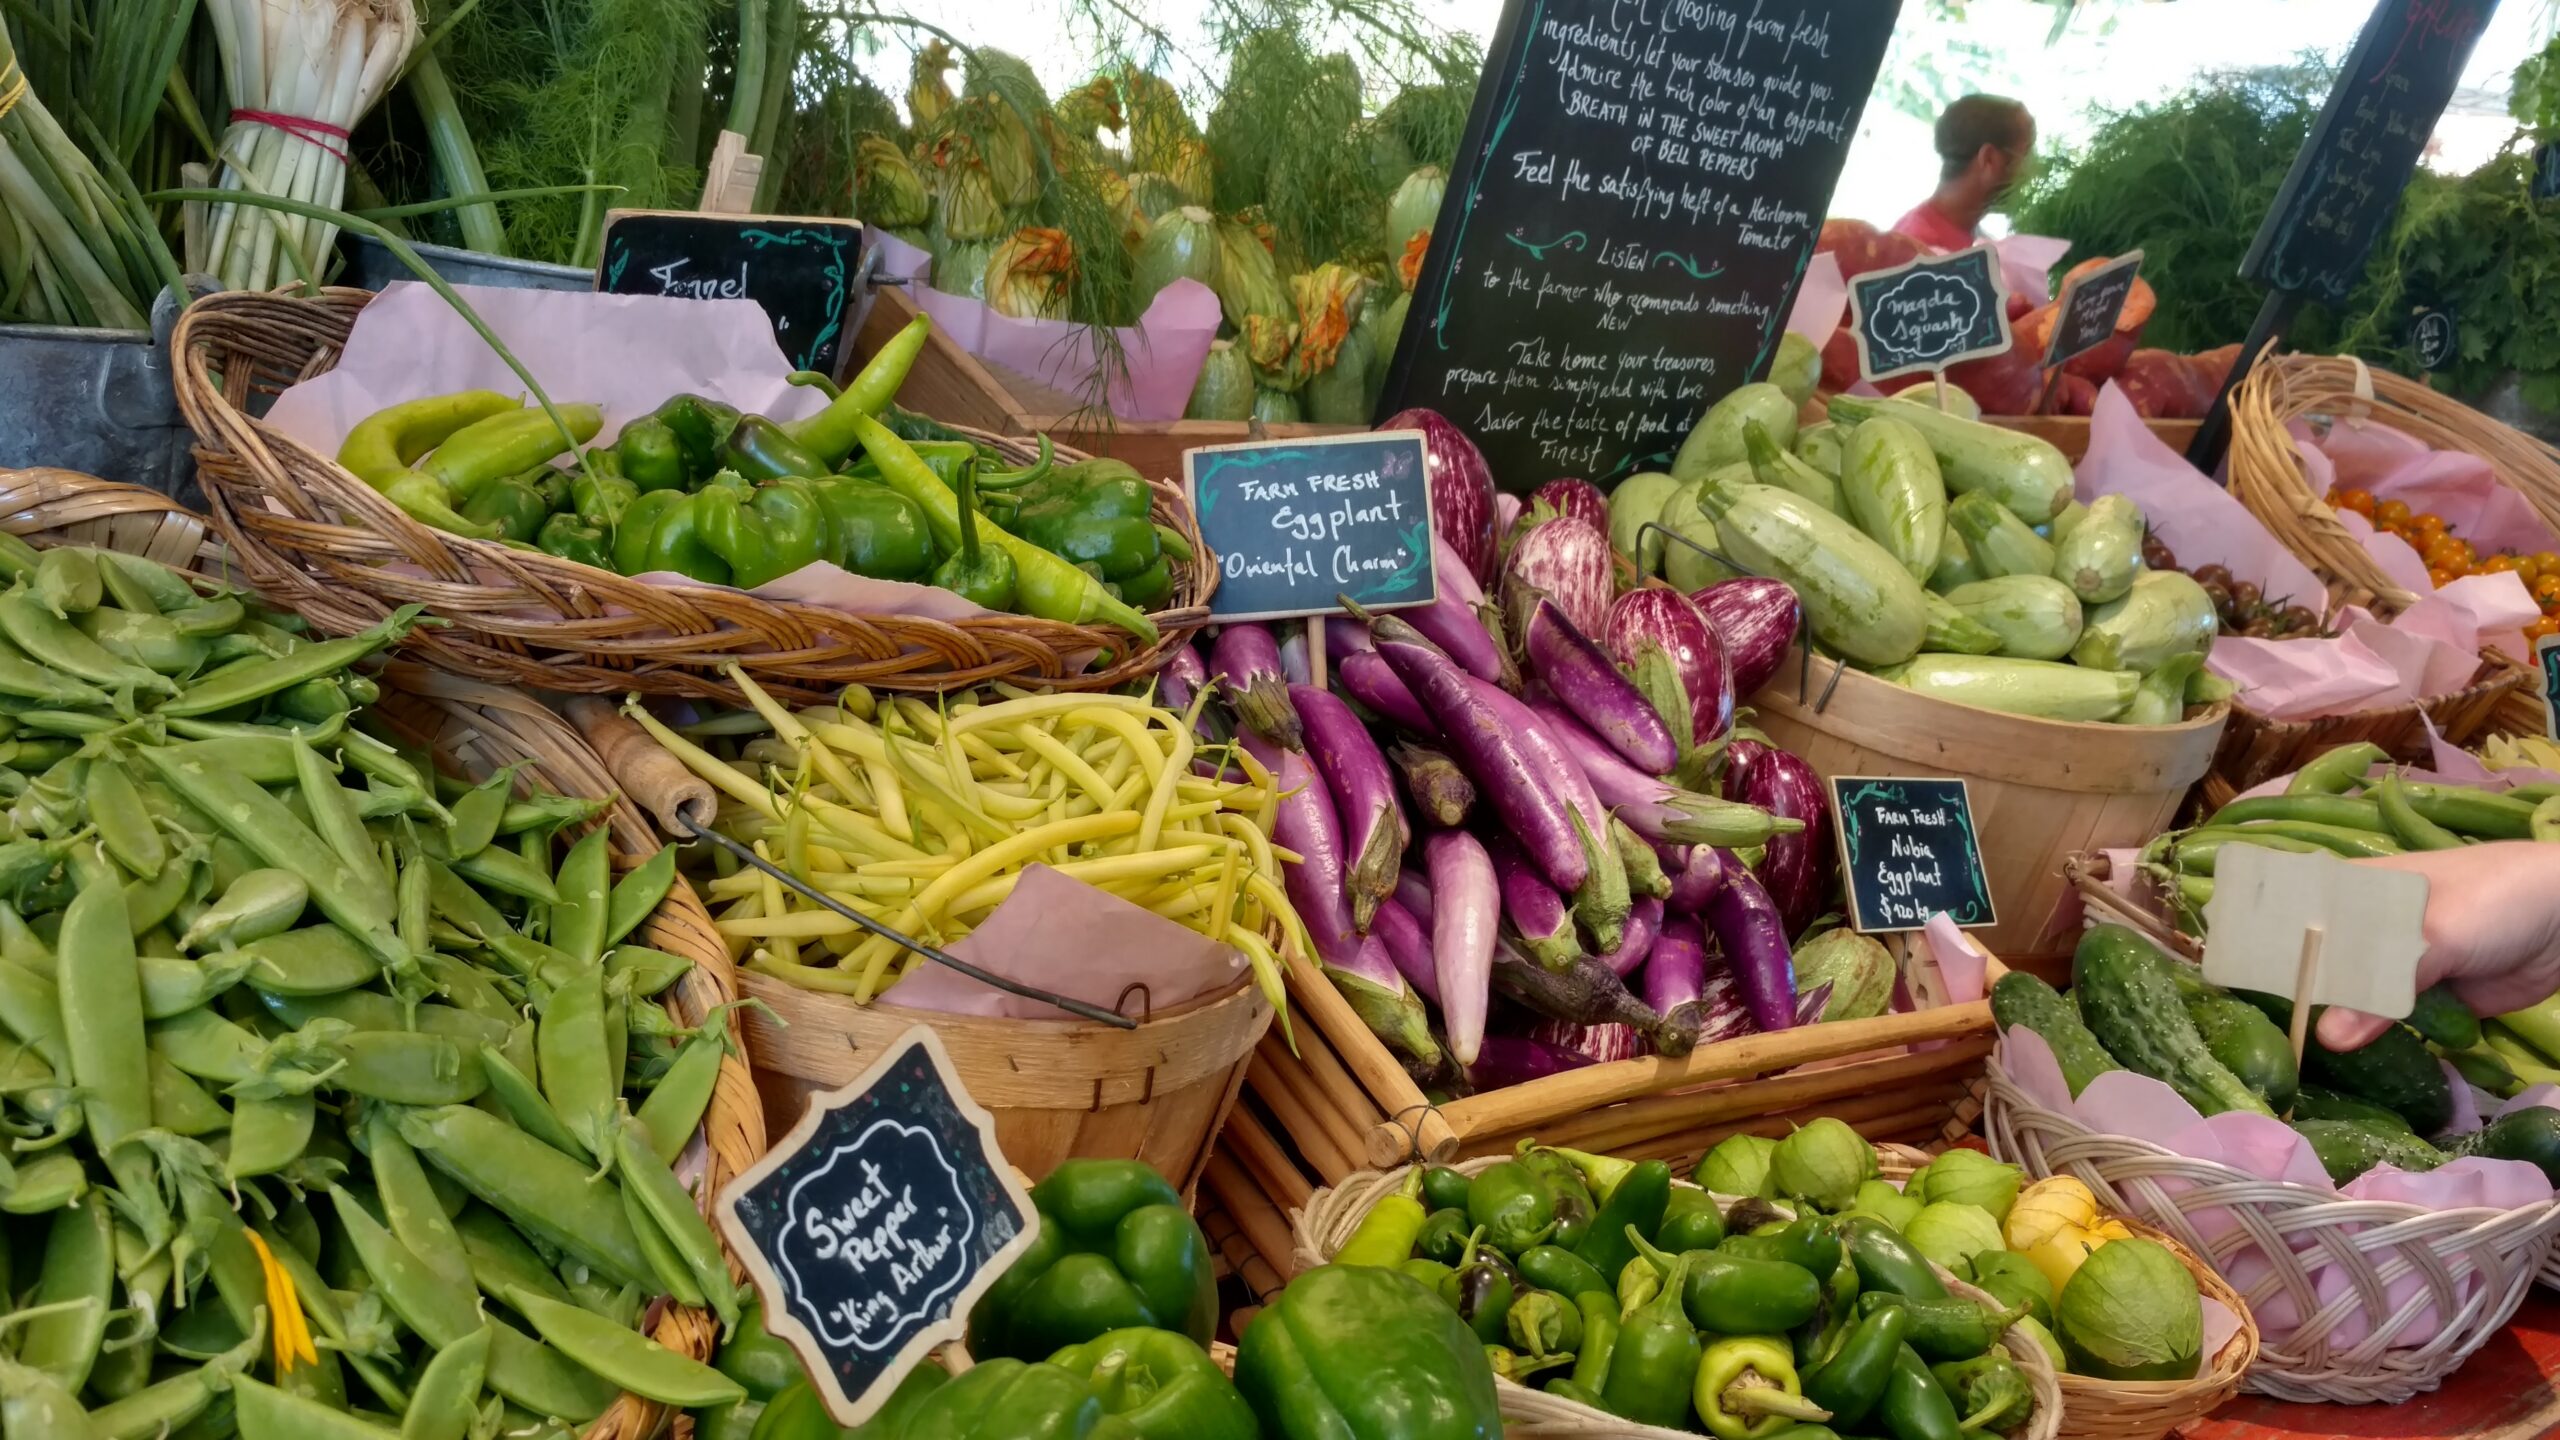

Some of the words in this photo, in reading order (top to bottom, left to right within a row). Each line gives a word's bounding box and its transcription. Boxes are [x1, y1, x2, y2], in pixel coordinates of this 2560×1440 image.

[1557, 50, 1623, 103] Admire
[1629, 71, 1656, 101] the
[1736, 94, 1757, 132] of
[1757, 106, 1776, 130] an
[1643, 34, 1667, 69] let
[1665, 52, 1702, 91] your
[1704, 60, 1755, 88] senses
[1753, 64, 1802, 111] guide
[1565, 90, 1628, 126] BREATH
[1661, 113, 1688, 138] THE
[1691, 121, 1741, 148] SWEET
[1740, 131, 1784, 160] AROMA
[1631, 135, 1654, 153] OF
[1657, 138, 1689, 165] BELL
[1699, 148, 1759, 181] PEPPERS
[1512, 150, 1556, 185] Feel
[1561, 158, 1591, 202] the
[1598, 165, 1675, 220] satisfying
[1680, 181, 1712, 226] heft
[1713, 193, 1731, 226] of
[1728, 203, 1741, 216] a
[1737, 223, 1796, 250] Tomato
[1483, 260, 1501, 288] to
[1507, 266, 1531, 297] the
[1535, 271, 1588, 310] farmer
[1626, 291, 1699, 316] recommends
[1706, 289, 1769, 331] something
[1596, 307, 1633, 331] NEW
[1508, 335, 1551, 367] Take
[1560, 342, 1608, 371] home
[1612, 351, 1648, 390] your
[1442, 367, 1498, 396] prepare
[1503, 367, 1540, 396] them
[1548, 374, 1600, 408] simply
[1599, 377, 1633, 399] and
[1640, 376, 1668, 408] with
[1474, 402, 1525, 432] Savor
[1531, 408, 1563, 439] the
[1564, 406, 1609, 439] taste
[1615, 410, 1635, 441] of
[1634, 413, 1670, 443] food
[1676, 407, 1694, 432] at
[1539, 435, 1603, 473] Finest
[1237, 479, 1299, 502] FARM
[1306, 470, 1381, 493] FRESH
[1271, 489, 1403, 541] Eggplant
[1875, 807, 1910, 827] FARM
[1891, 833, 1935, 859] Nubia
[1877, 861, 1942, 896] Eggplant
[805, 1158, 893, 1260] Sweet
[840, 1184, 918, 1274] Pepper
